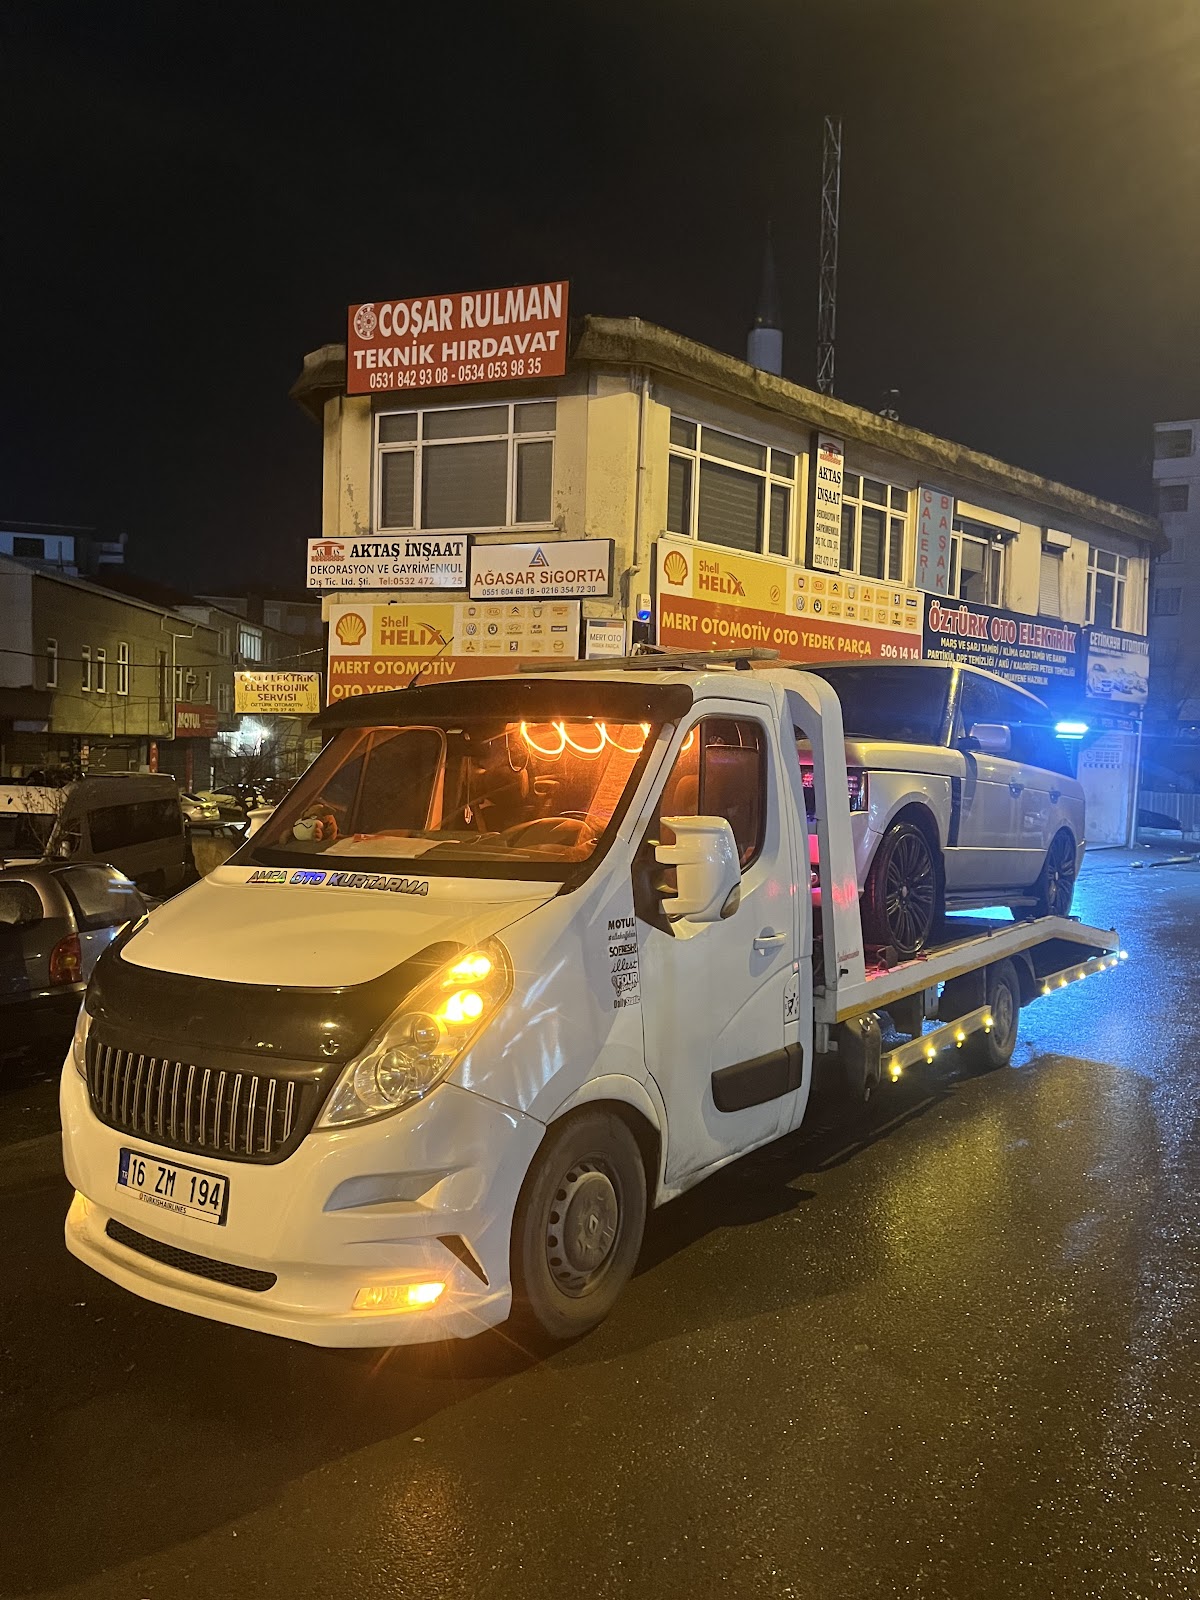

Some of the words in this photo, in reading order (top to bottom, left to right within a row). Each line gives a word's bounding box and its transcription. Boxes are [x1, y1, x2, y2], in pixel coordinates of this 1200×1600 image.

[378, 298, 453, 338] COŞAR
[460, 284, 562, 329] RULMAN
[354, 340, 435, 370] TEKNİK
[441, 330, 560, 362] HIRDAVAT
[369, 371, 394, 389] 0531
[397, 369, 417, 388] 842
[419, 368, 433, 385] 93
[435, 366, 448, 383] 08
[458, 363, 485, 382] 0534
[487, 361, 508, 380] 053
[510, 359, 525, 376] 98
[527, 357, 542, 375] 35
[818, 465, 841, 487] AKTAŞ
[350, 543, 400, 562] AKTAŞ
[405, 538, 463, 561] İNŞAAT
[310, 564, 375, 575] DEKORASYON
[377, 564, 389, 574] VE
[392, 560, 463, 574] GAYRİMENKUL
[699, 560, 720, 574] Shell
[310, 577, 323, 588] Dış
[325, 577, 339, 586] Tic.
[341, 577, 356, 586] Ltd.
[358, 577, 371, 588] Şti.
[418, 576, 434, 585] 472
[451, 576, 463, 585] 25
[473, 570, 535, 586] AĞASAR
[699, 574, 745, 597] HELIX
[482, 588, 499, 596] 0551
[526, 587, 535, 595] 18
[560, 586, 574, 594] 354
[381, 615, 409, 628] Shell
[928, 600, 990, 639] ÖZTÜRK
[991, 617, 1017, 644] OTO
[1018, 625, 1077, 654] ELEKTRİK
[380, 627, 445, 646] HELIX
[590, 633, 606, 641] MERT
[607, 634, 622, 642] OTO
[662, 611, 698, 632] MERT
[701, 619, 771, 642] OTOMOTİV
[773, 628, 799, 645] OTO
[801, 631, 835, 651] YEDEK
[838, 637, 872, 658] PARÇA
[880, 644, 898, 659] 506
[899, 646, 909, 660] 14
[910, 648, 919, 660] 14
[940, 637, 958, 650] MARŞ
[958, 640, 966, 650] VE
[332, 661, 371, 675] MERT
[373, 657, 456, 675] OTOMOTİV
[331, 684, 363, 698] OTO
[178, 711, 201, 729] MOTUL
[289, 870, 327, 886] OTO
[326, 872, 429, 897] KURTARMA
[608, 917, 635, 930] MOTUL
[122, 1170, 128, 1179] TR
[131, 1158, 146, 1187] 16
[154, 1166, 177, 1198] ZM
[189, 1176, 221, 1210] 194
